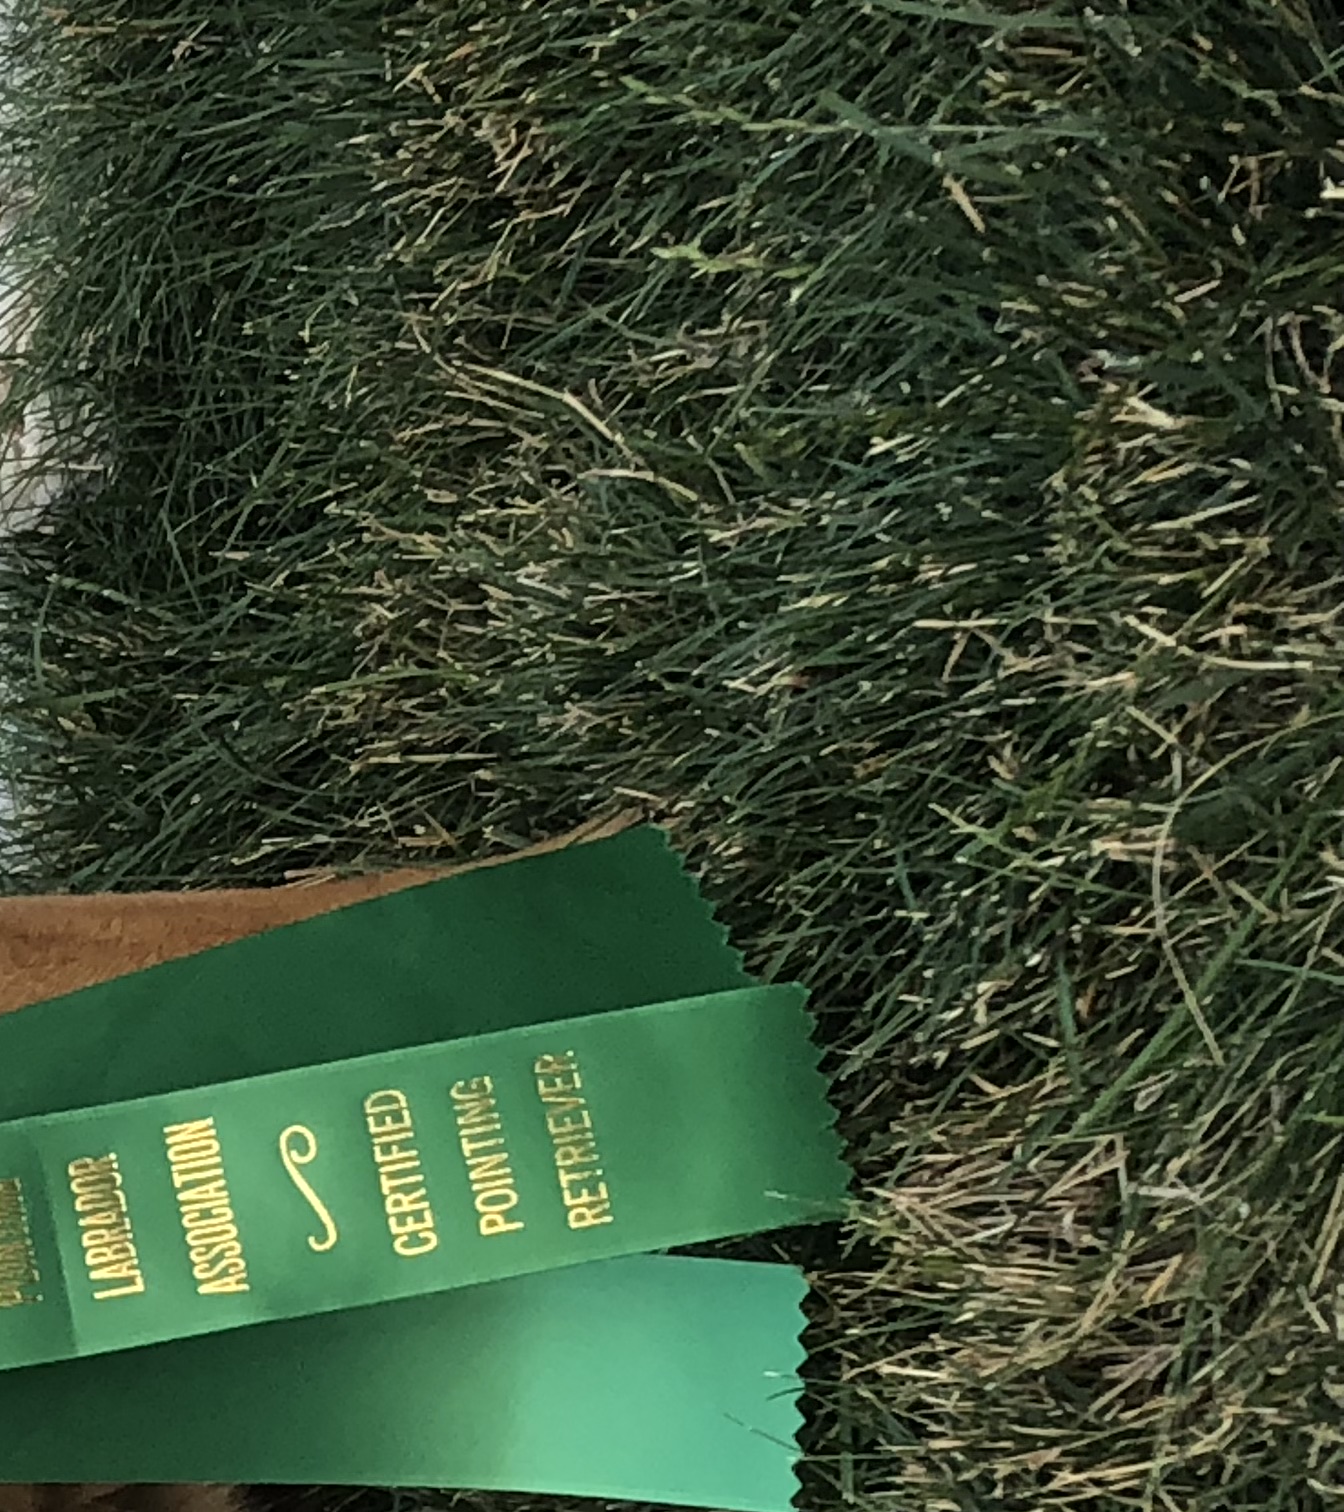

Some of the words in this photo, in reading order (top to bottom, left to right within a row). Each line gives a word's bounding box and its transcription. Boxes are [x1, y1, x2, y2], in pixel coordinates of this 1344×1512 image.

[163, 1115, 250, 1296] ASSOCIATION
[363, 1088, 439, 1257] CERTIFIED
[449, 1075, 525, 1238] POINTING
[534, 1049, 614, 1230] RETRIEVER
[67, 1151, 146, 1300] LABRADOR
